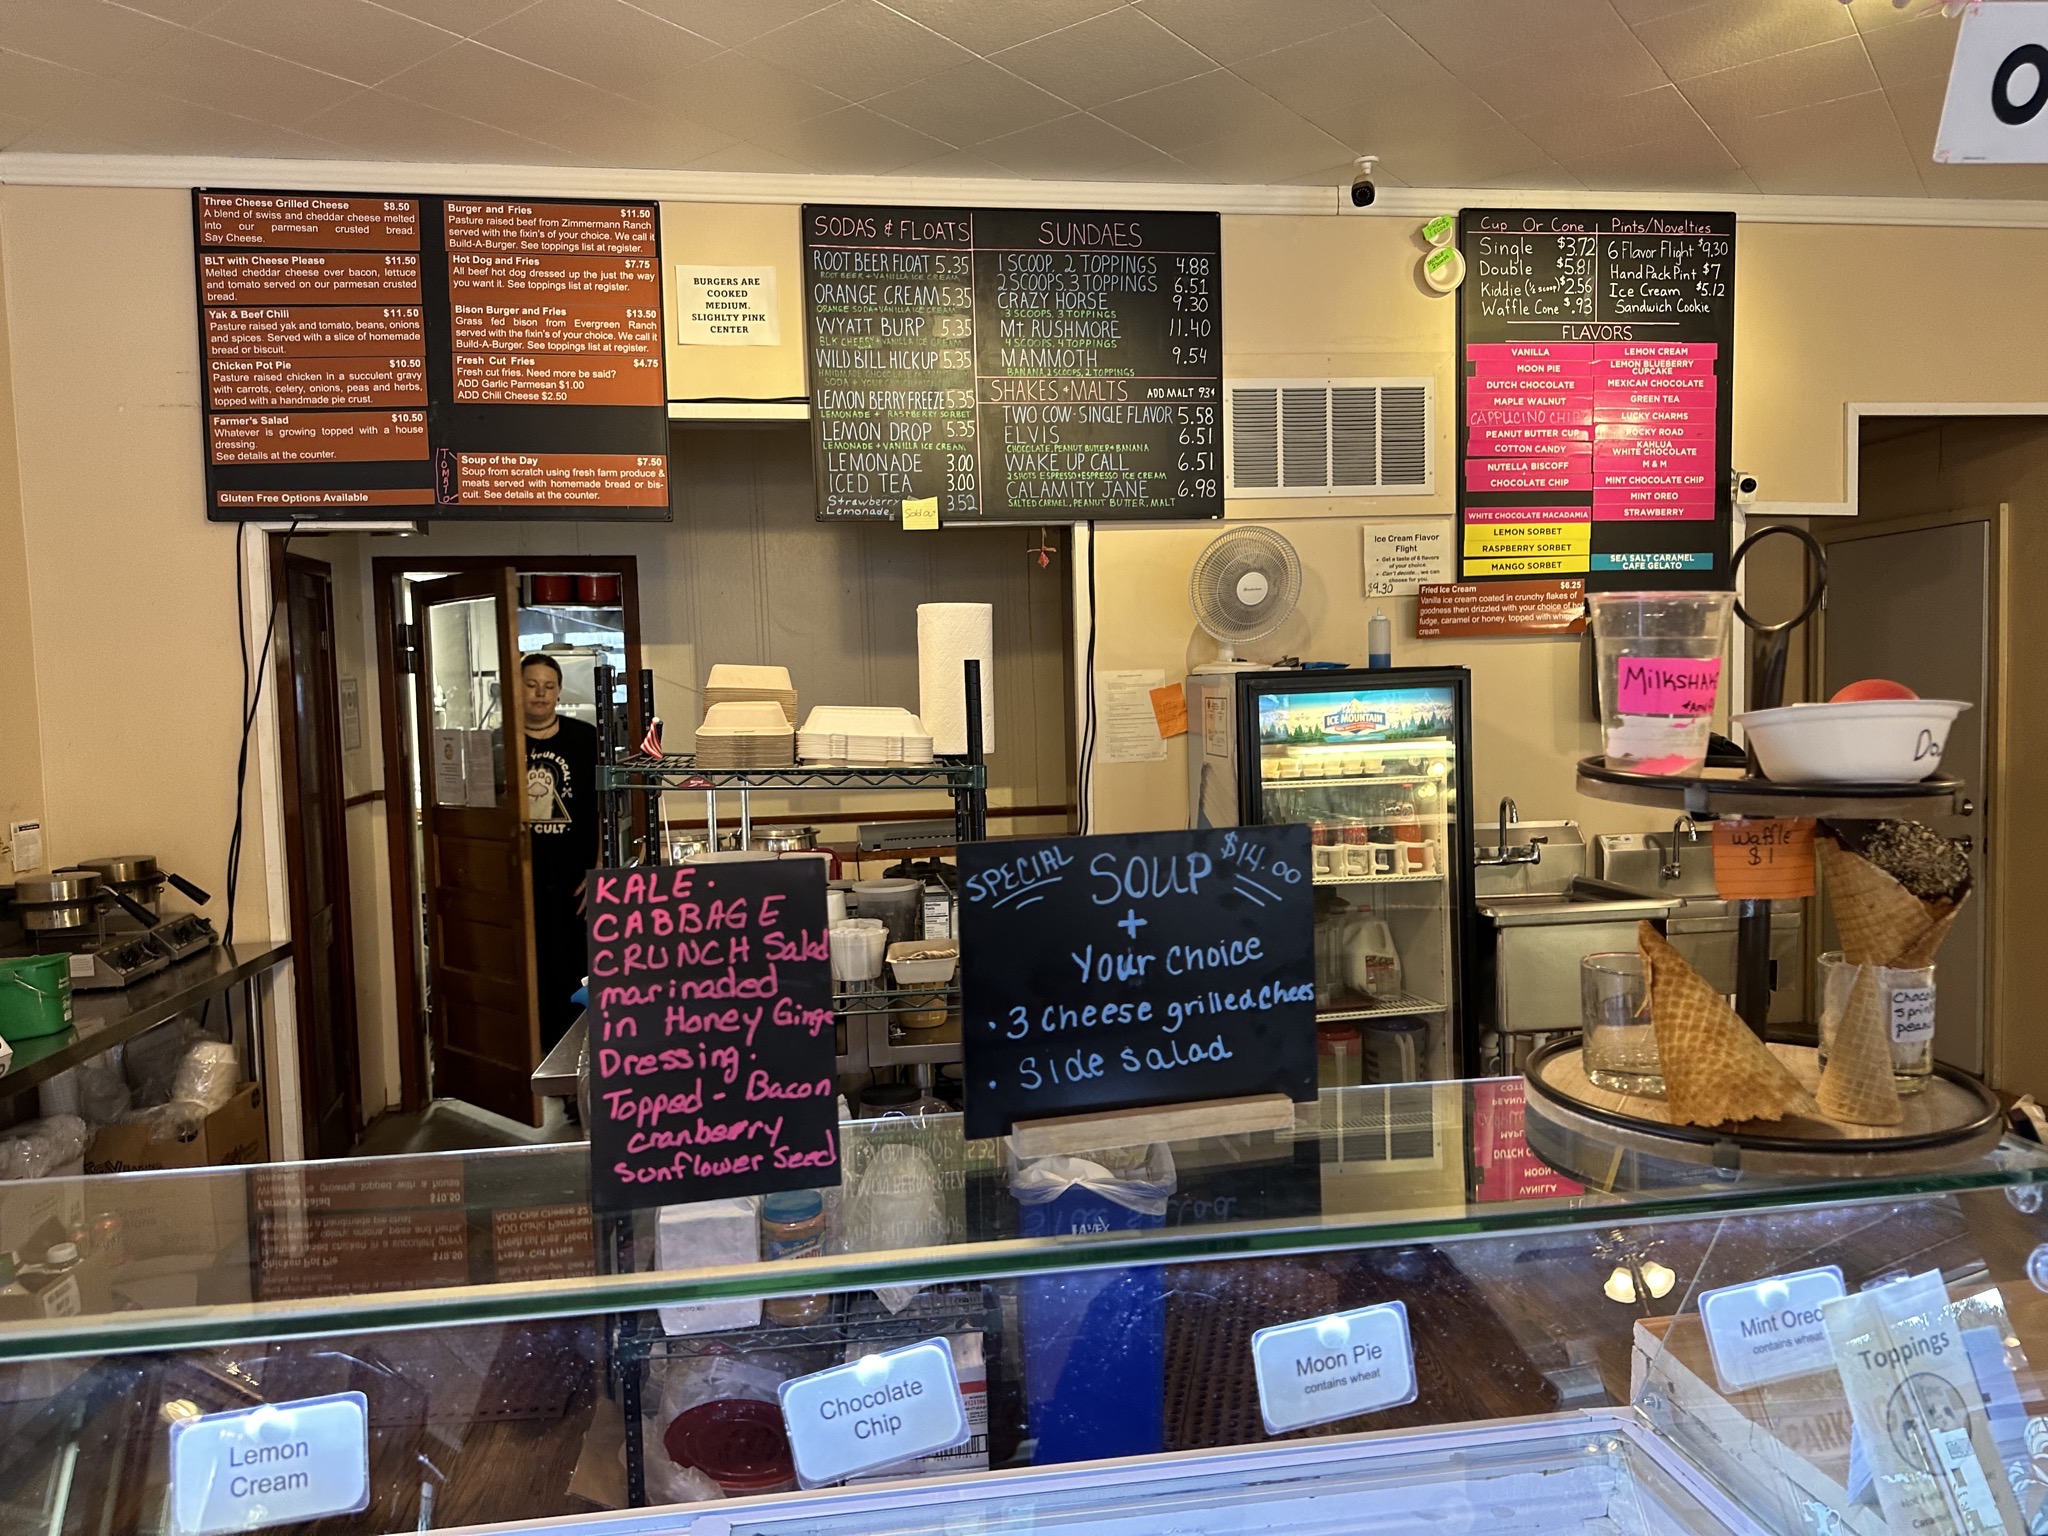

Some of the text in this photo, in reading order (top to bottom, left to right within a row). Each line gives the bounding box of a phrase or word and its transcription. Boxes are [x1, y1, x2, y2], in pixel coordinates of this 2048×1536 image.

[204, 197, 410, 212] Three Cheese Grilled Cheese $8.50
[448, 204, 650, 219] Burger and Fries $11.50
[815, 216, 877, 238] SODAS
[901, 220, 970, 242] FLOATS
[1481, 216, 1585, 232] Cup Or Cone
[1612, 217, 1711, 233] Pints/Novelties
[1038, 221, 1143, 248] SUNDAES
[1480, 236, 1596, 264] Single $3.72
[205, 256, 416, 266] BLT with Cheese Please $11.50
[1480, 257, 1591, 276] Double $5.81
[694, 278, 760, 286] BURGERS ARE
[707, 290, 748, 298] COOKED
[209, 309, 419, 319] Yak & Beef Chili $11.50
[706, 302, 751, 310] MEDIUM.
[1482, 299, 1530, 316] Waffle
[1535, 299, 1559, 315] Cone
[1615, 298, 1710, 314] Sandwich Cookie
[816, 316, 972, 337] WYATT BURP 5.35
[1562, 325, 1633, 340] FLAVORS
[1001, 347, 1207, 368] MAMMOTH 9.54
[1625, 348, 1689, 356] LEMON CREAM
[212, 359, 421, 371] Chicken Pot Pie $10.50
[457, 356, 659, 368] Fresh Cut Fries $4.75
[1517, 365, 1561, 373] MOON PIE
[991, 380, 1059, 402] SHAKES
[1070, 380, 1128, 401] MALTS
[1487, 381, 1575, 389] DUTCH CHOCOLATE
[1651, 380, 1704, 388] CHOCOLATE
[214, 413, 423, 426] Farmer's Salad $10.50
[1005, 426, 1212, 445] ELVIS 6.51
[462, 456, 662, 467] Soup of the Day $7.50
[828, 452, 974, 473] LEMONADE 3.00
[1005, 452, 1214, 472] WAKE UP CALL 6.51
[830, 473, 975, 493] ICED TEA 3.00
[1006, 479, 1217, 499] CALAMITY JANE 6.98
[221, 493, 368, 504] Gluten Free Options Available
[1624, 508, 1684, 516] STRAWBERRY
[1375, 534, 1440, 543] Ice Cream Flavor
[1494, 528, 1562, 536] LEMON SORBET
[1396, 545, 1417, 553] Flight
[1421, 586, 1438, 594] Fried
[1327, 713, 1383, 726] ICE MOUNTAIN
[534, 824, 567, 834] CULT
[966, 832, 1301, 905] SPECIAL SOUP $14.00
[593, 895, 786, 942] CABBAGE
[593, 928, 830, 977] CRUNCH Salad
[1072, 944, 1156, 983] Your
[600, 963, 779, 1010] marinaded
[1007, 1007, 1029, 1038] 3
[1162, 988, 1256, 1033] grilled
[603, 1020, 638, 1042] in
[665, 1005, 763, 1046] Honey
[603, 1071, 831, 1127] Topped Bacon
[1740, 1315, 1778, 1338] Mint
[1753, 1339, 1794, 1355] contains
[1858, 1331, 1950, 1370] Toppings
[1296, 1343, 1382, 1376] Moon Pie
[1305, 1368, 1381, 1394] contains wheat
[820, 1380, 924, 1420] Chocolate
[855, 1414, 902, 1440] Chip
[229, 1438, 309, 1468] Lemon
[230, 1469, 309, 1498] Cream
